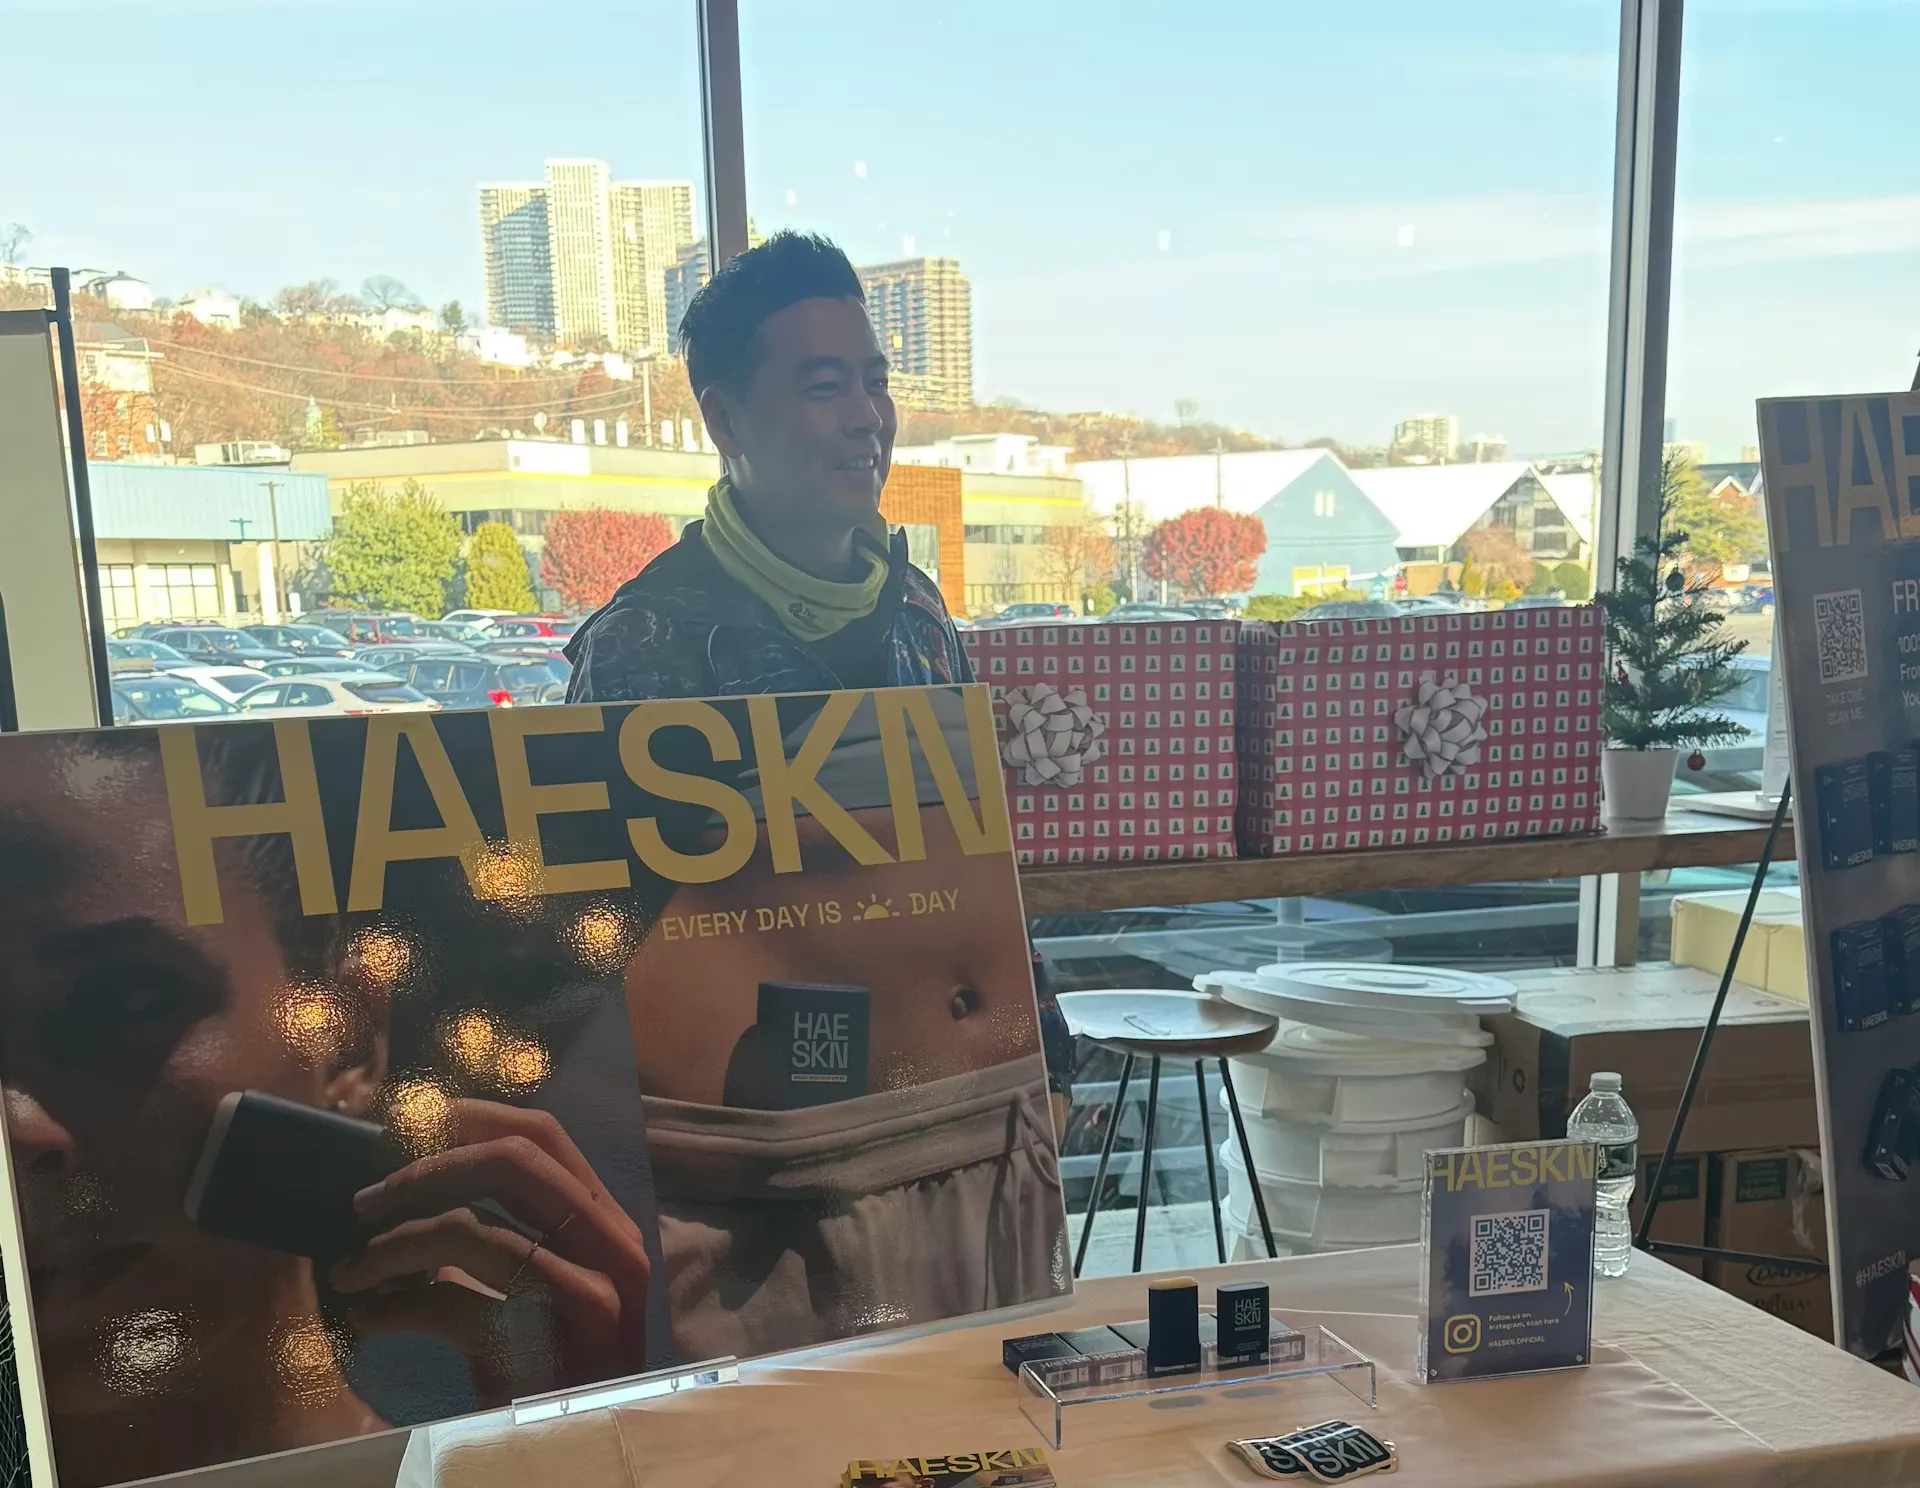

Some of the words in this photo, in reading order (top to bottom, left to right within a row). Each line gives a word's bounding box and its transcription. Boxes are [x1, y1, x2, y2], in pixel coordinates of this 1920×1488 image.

[1892, 579, 1920, 614] FR
[157, 685, 1012, 926] HAESKN
[661, 910, 747, 941] EVERY
[756, 904, 809, 931] DAY
[817, 900, 841, 925] IS
[908, 888, 959, 915] DAY
[793, 1011, 850, 1041] HAE
[791, 1040, 849, 1069] SKN
[1431, 1144, 1594, 1193] HAESKN
[1855, 1250, 1906, 1288] #HAESKN
[1234, 1297, 1261, 1313] HAE
[1234, 1310, 1261, 1326] SKN
[1488, 1314, 1511, 1322] Follow
[1512, 1312, 1521, 1320] us
[848, 1448, 1049, 1480] HAESKN
[1308, 1433, 1384, 1473] SKN
